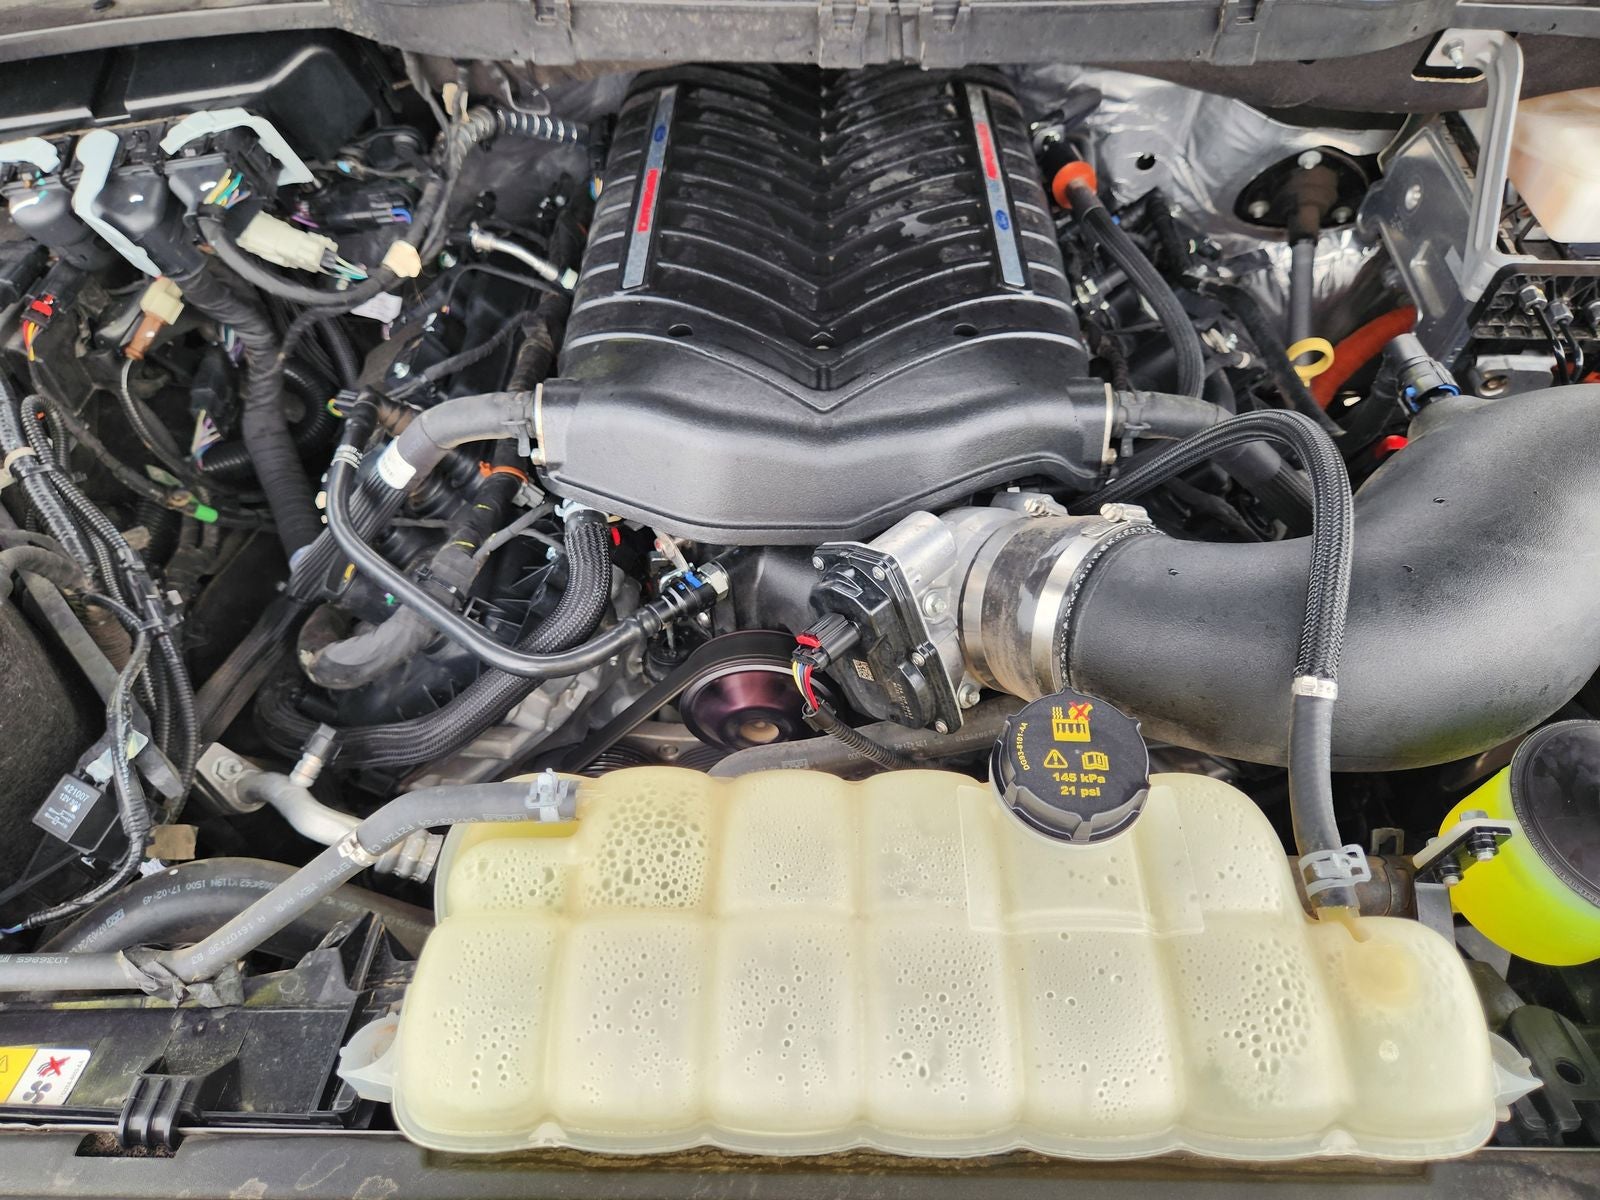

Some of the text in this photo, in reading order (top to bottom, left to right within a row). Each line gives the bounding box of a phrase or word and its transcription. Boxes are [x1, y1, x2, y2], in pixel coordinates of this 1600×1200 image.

[1052, 772, 1106, 784] 145 kPa
[1060, 786, 1101, 798] 21 psi
